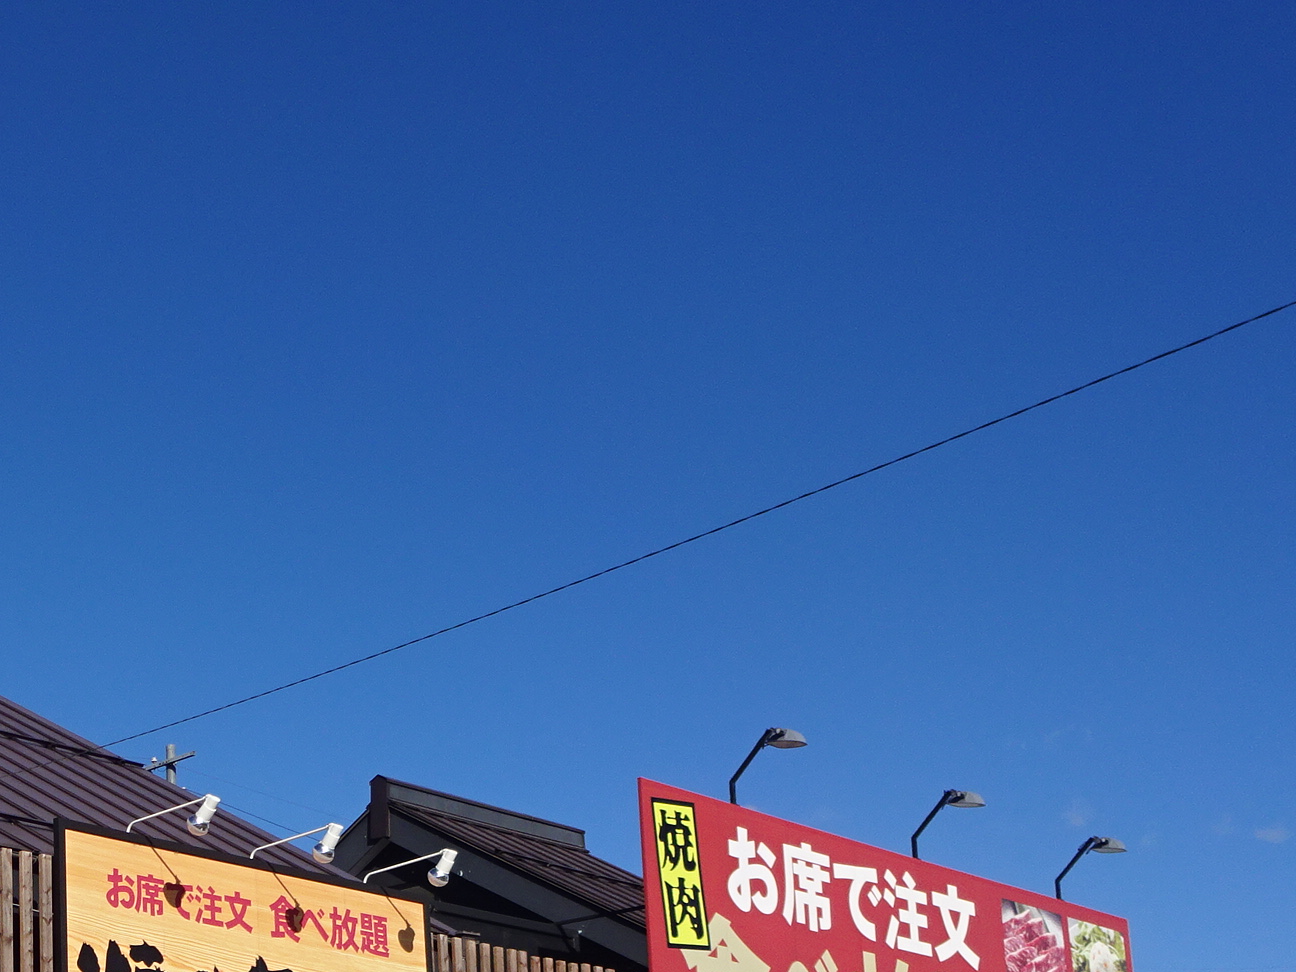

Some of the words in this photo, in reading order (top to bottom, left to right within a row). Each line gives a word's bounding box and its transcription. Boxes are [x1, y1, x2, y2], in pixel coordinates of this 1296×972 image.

[105, 868, 253, 934] お席で注文
[269, 895, 390, 958] 食べ放題
[658, 809, 705, 941] 焼肉
[726, 826, 980, 971] お席で注文
